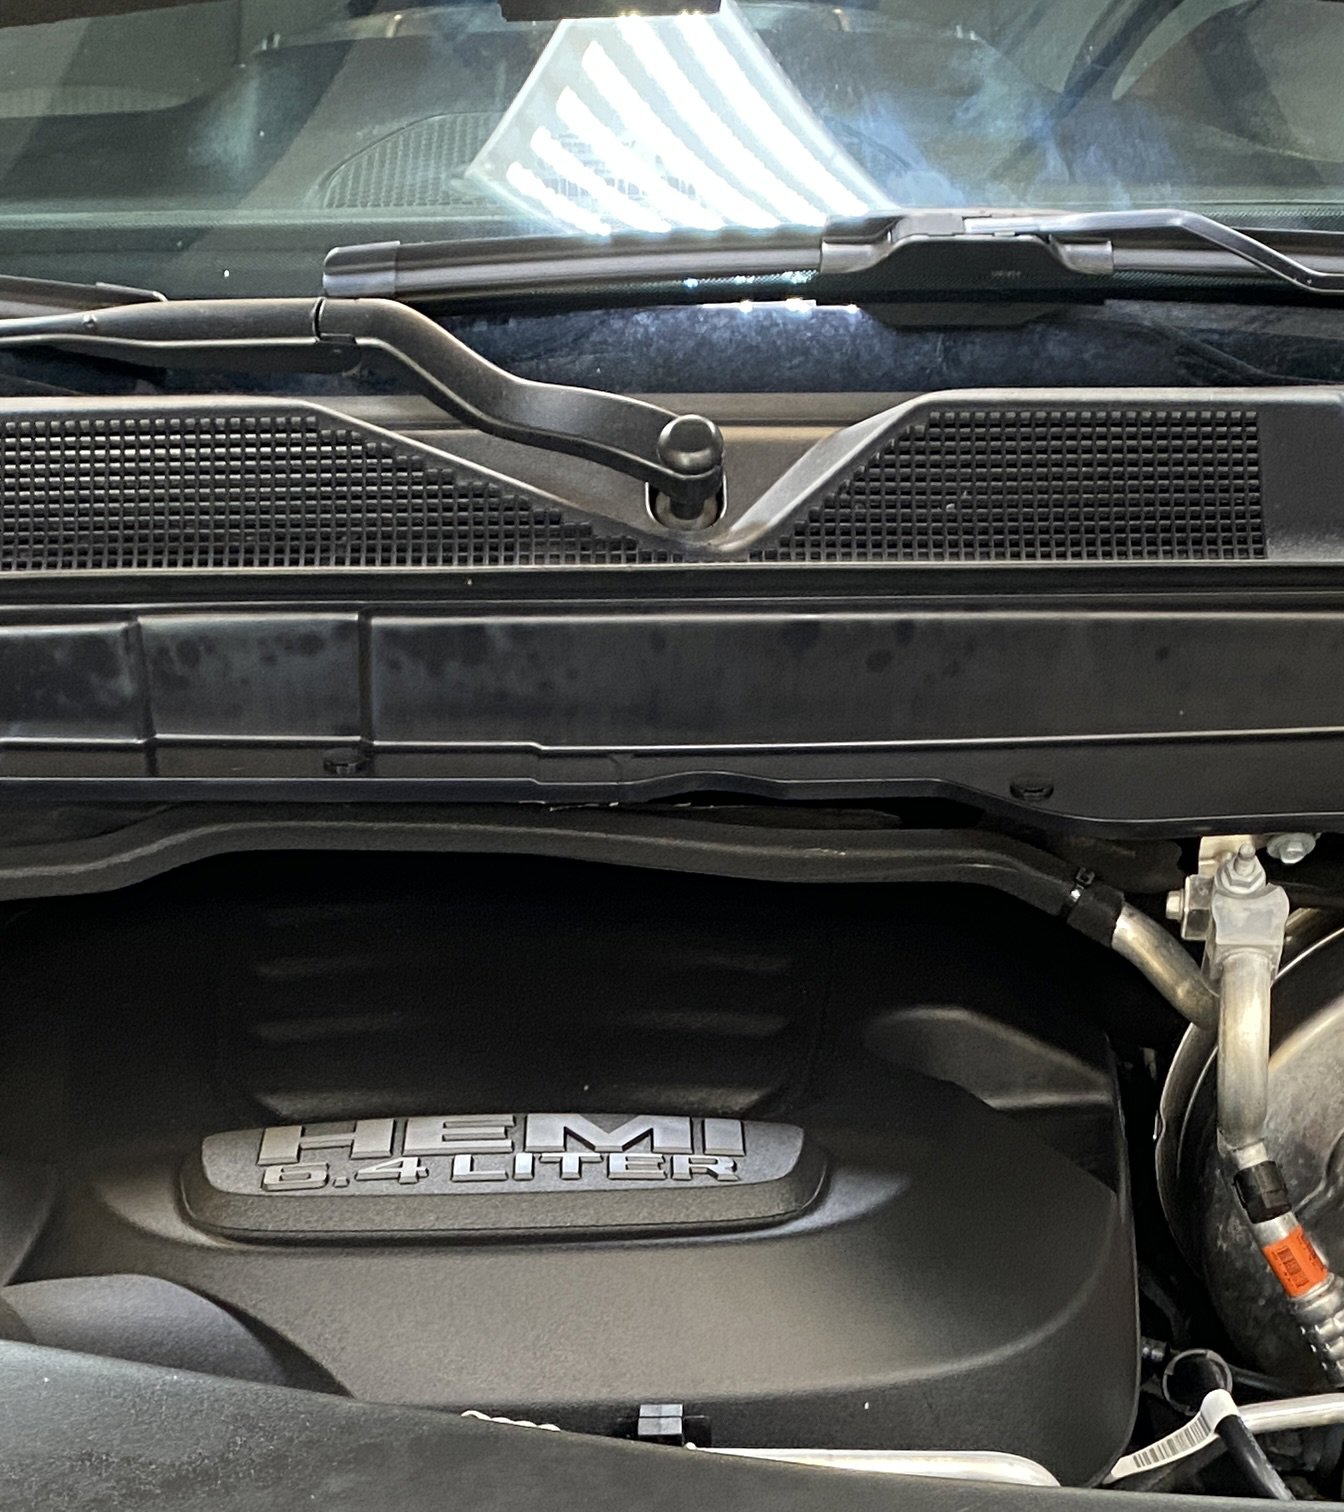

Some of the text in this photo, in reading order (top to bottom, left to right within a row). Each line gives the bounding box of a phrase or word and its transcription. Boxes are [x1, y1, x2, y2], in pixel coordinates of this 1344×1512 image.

[258, 1112, 747, 1166] HEMI
[260, 1152, 741, 1191] 6.4 LITER
